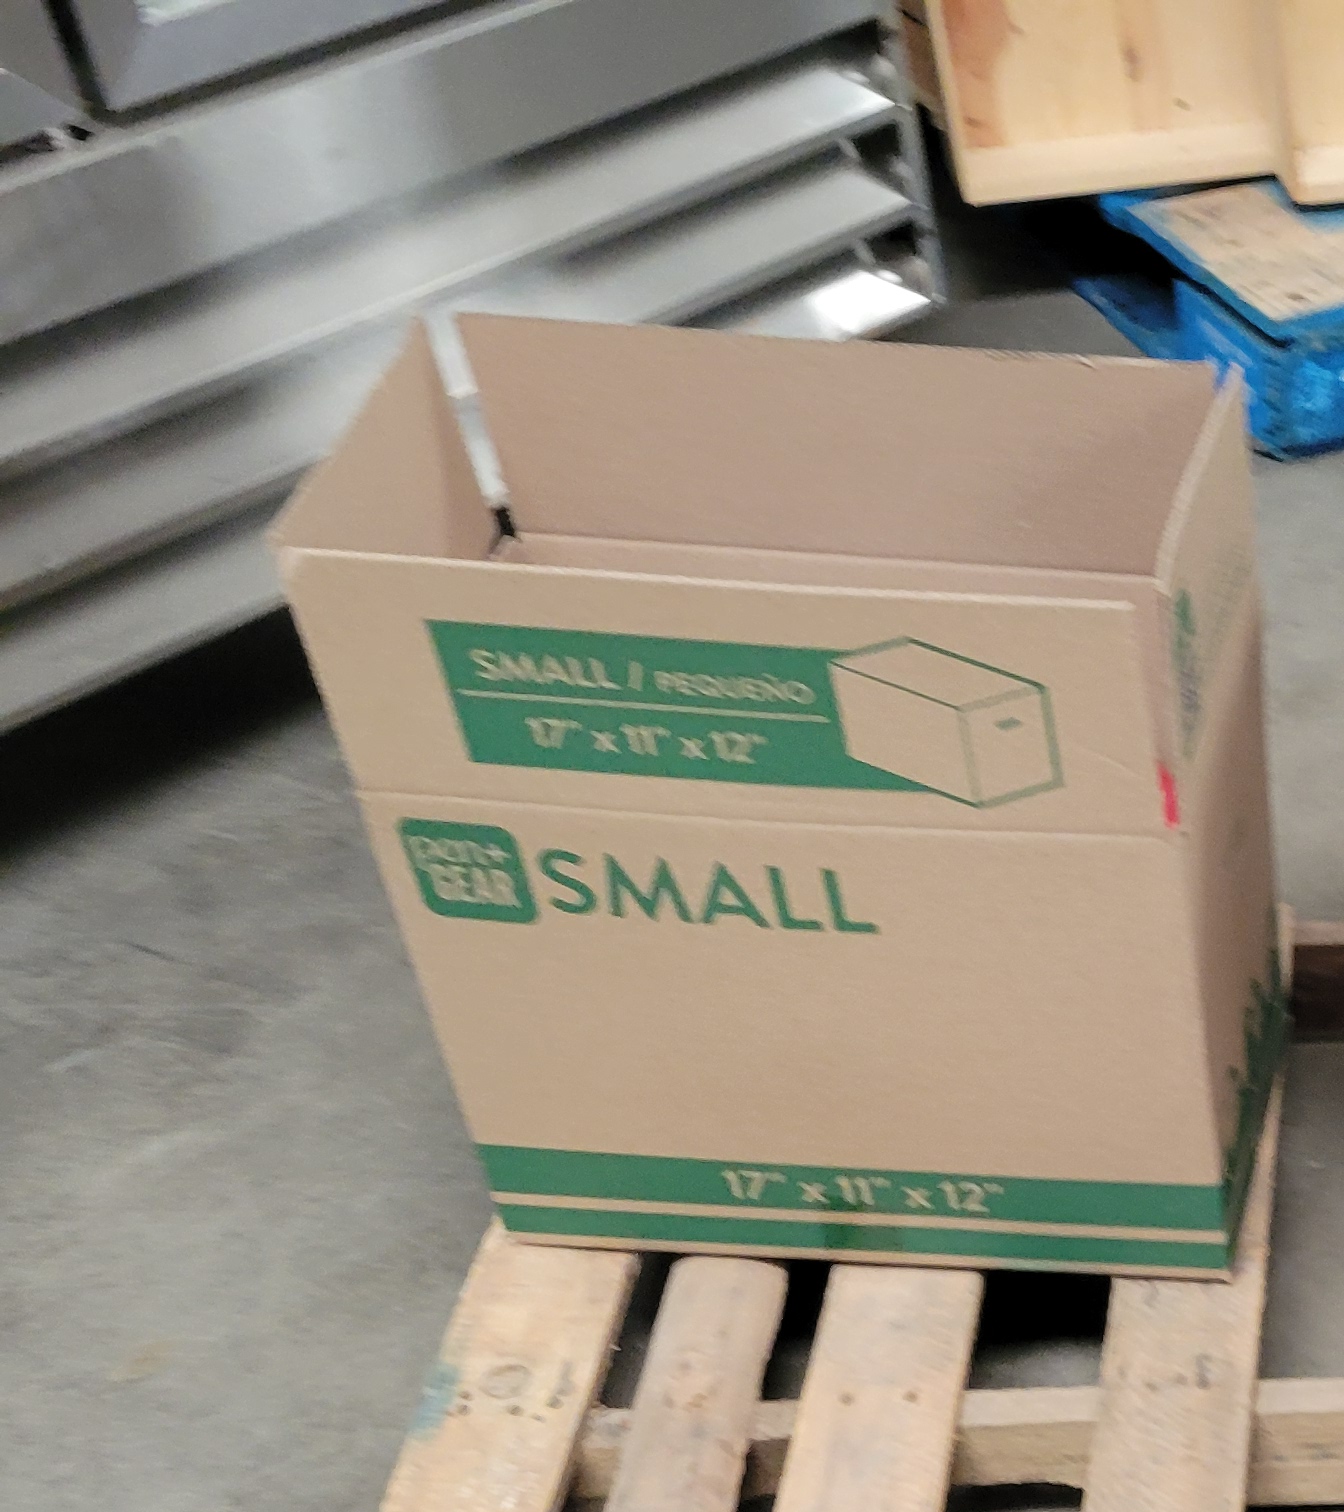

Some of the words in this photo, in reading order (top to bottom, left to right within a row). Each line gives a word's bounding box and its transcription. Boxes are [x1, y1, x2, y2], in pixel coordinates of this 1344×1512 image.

[469, 648, 621, 692] SMALL
[539, 848, 880, 935] SMALL
[721, 1168, 788, 1201] 17"
